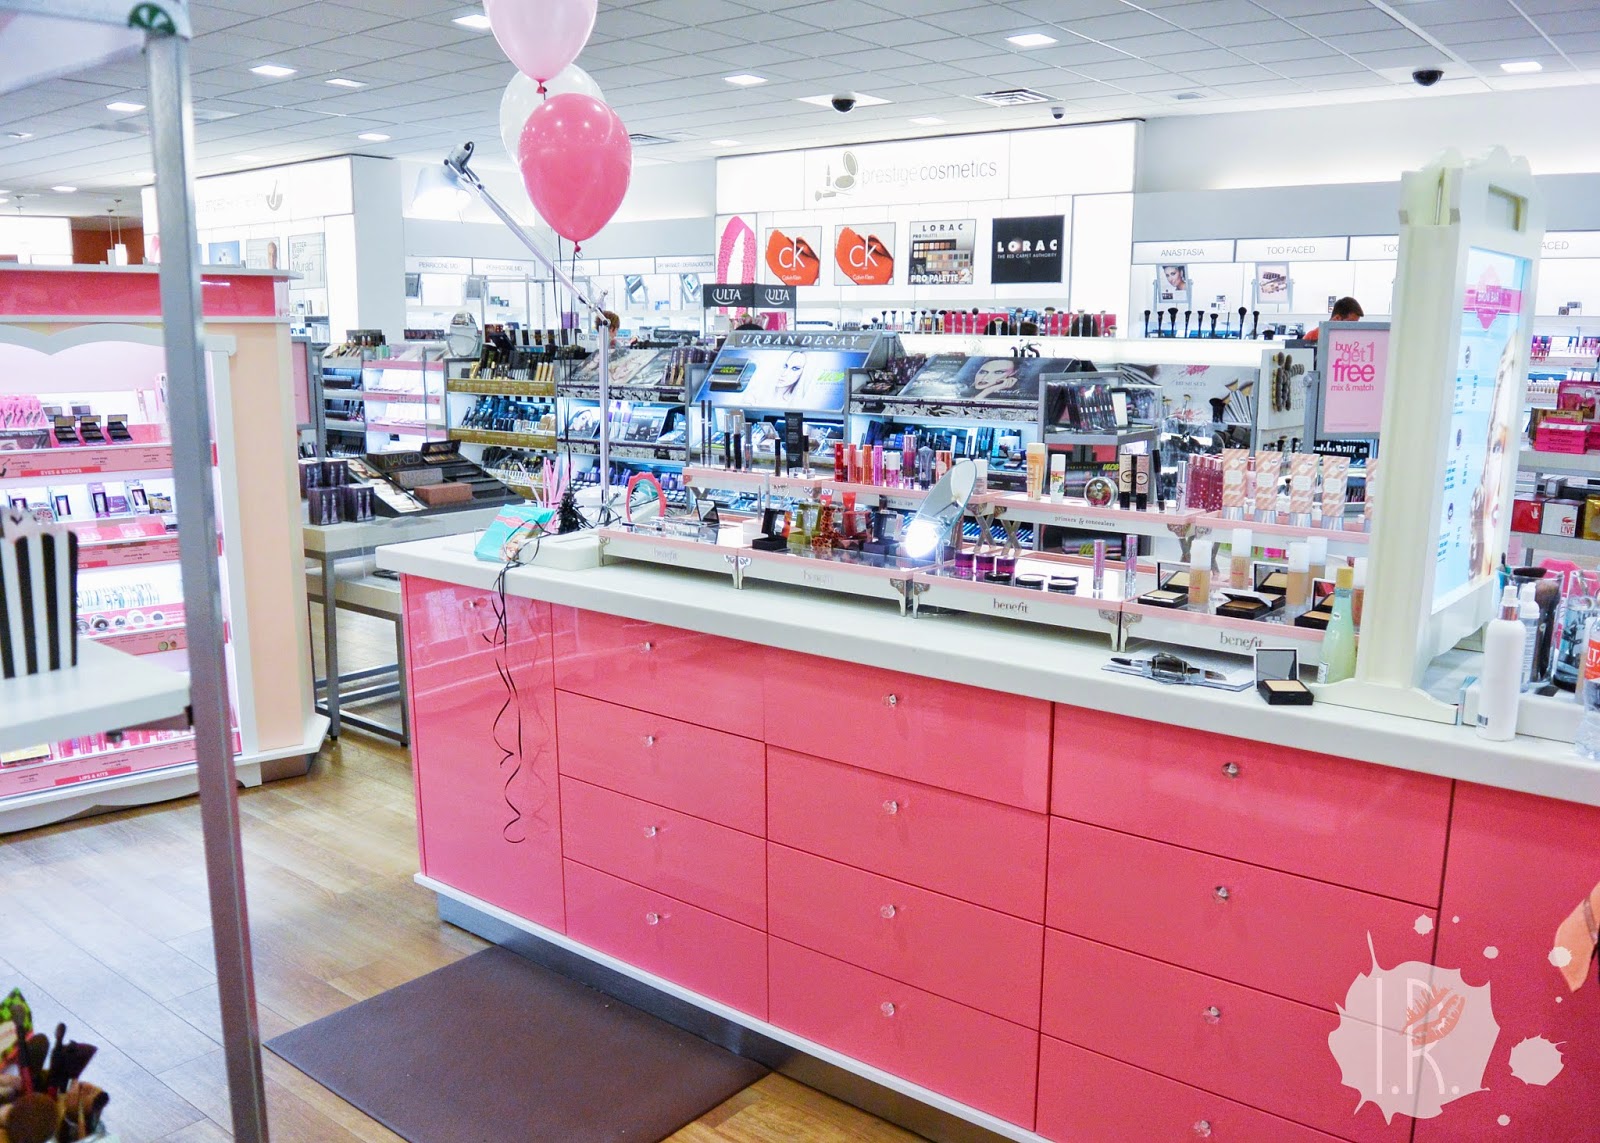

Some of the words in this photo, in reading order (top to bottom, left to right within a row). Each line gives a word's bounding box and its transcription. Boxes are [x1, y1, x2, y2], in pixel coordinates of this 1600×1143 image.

[922, 223, 963, 232] LORAC
[997, 239, 1058, 253] LORAC
[1266, 246, 1286, 256] TOO
[1286, 245, 1316, 255] FACED
[1541, 241, 1570, 250] ACED
[1160, 248, 1205, 257] ANASTASIA
[292, 260, 314, 272] Murad
[910, 274, 928, 283] PRO
[928, 273, 959, 283] PALETTE
[714, 287, 741, 302] ULTA
[767, 288, 790, 302] ULTA
[740, 334, 798, 347] URBAN
[801, 335, 860, 347] DECAY
[1335, 341, 1353, 353] buy
[1353, 341, 1360, 352] 2
[1341, 347, 1366, 366] get
[1366, 341, 1375, 362] 1
[1332, 358, 1375, 383] free
[1330, 384, 1344, 392] mix
[1351, 383, 1375, 392] match
[384, 452, 421, 466] NAKED
[1054, 515, 1077, 524] primers
[1085, 518, 1116, 527] concealers
[993, 597, 1028, 613] benefit
[1219, 631, 1263, 649] benefit
